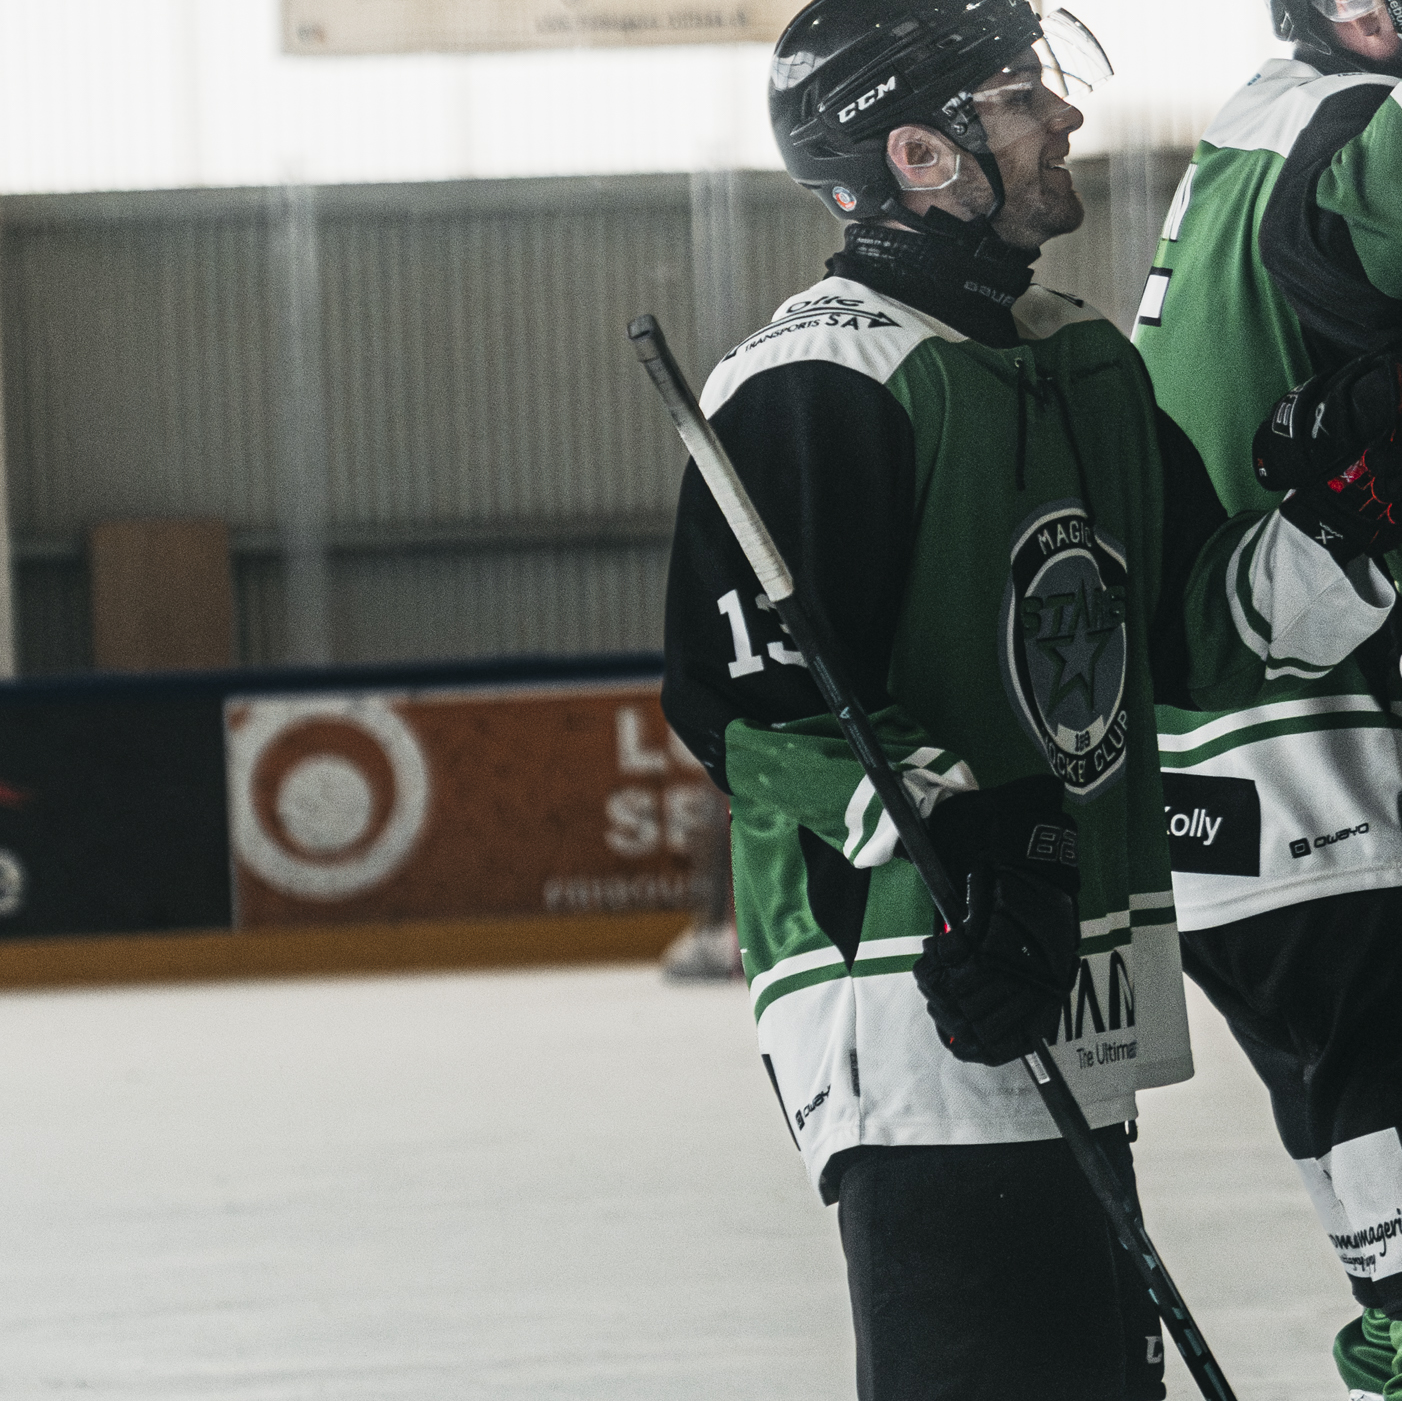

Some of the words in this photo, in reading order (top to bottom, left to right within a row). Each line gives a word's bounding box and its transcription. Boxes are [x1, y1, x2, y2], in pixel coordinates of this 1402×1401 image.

[837, 75, 896, 125] CCM
[744, 319, 821, 353] TRANSPORTS
[825, 312, 860, 331] SA
[1164, 805, 1224, 847] olly
